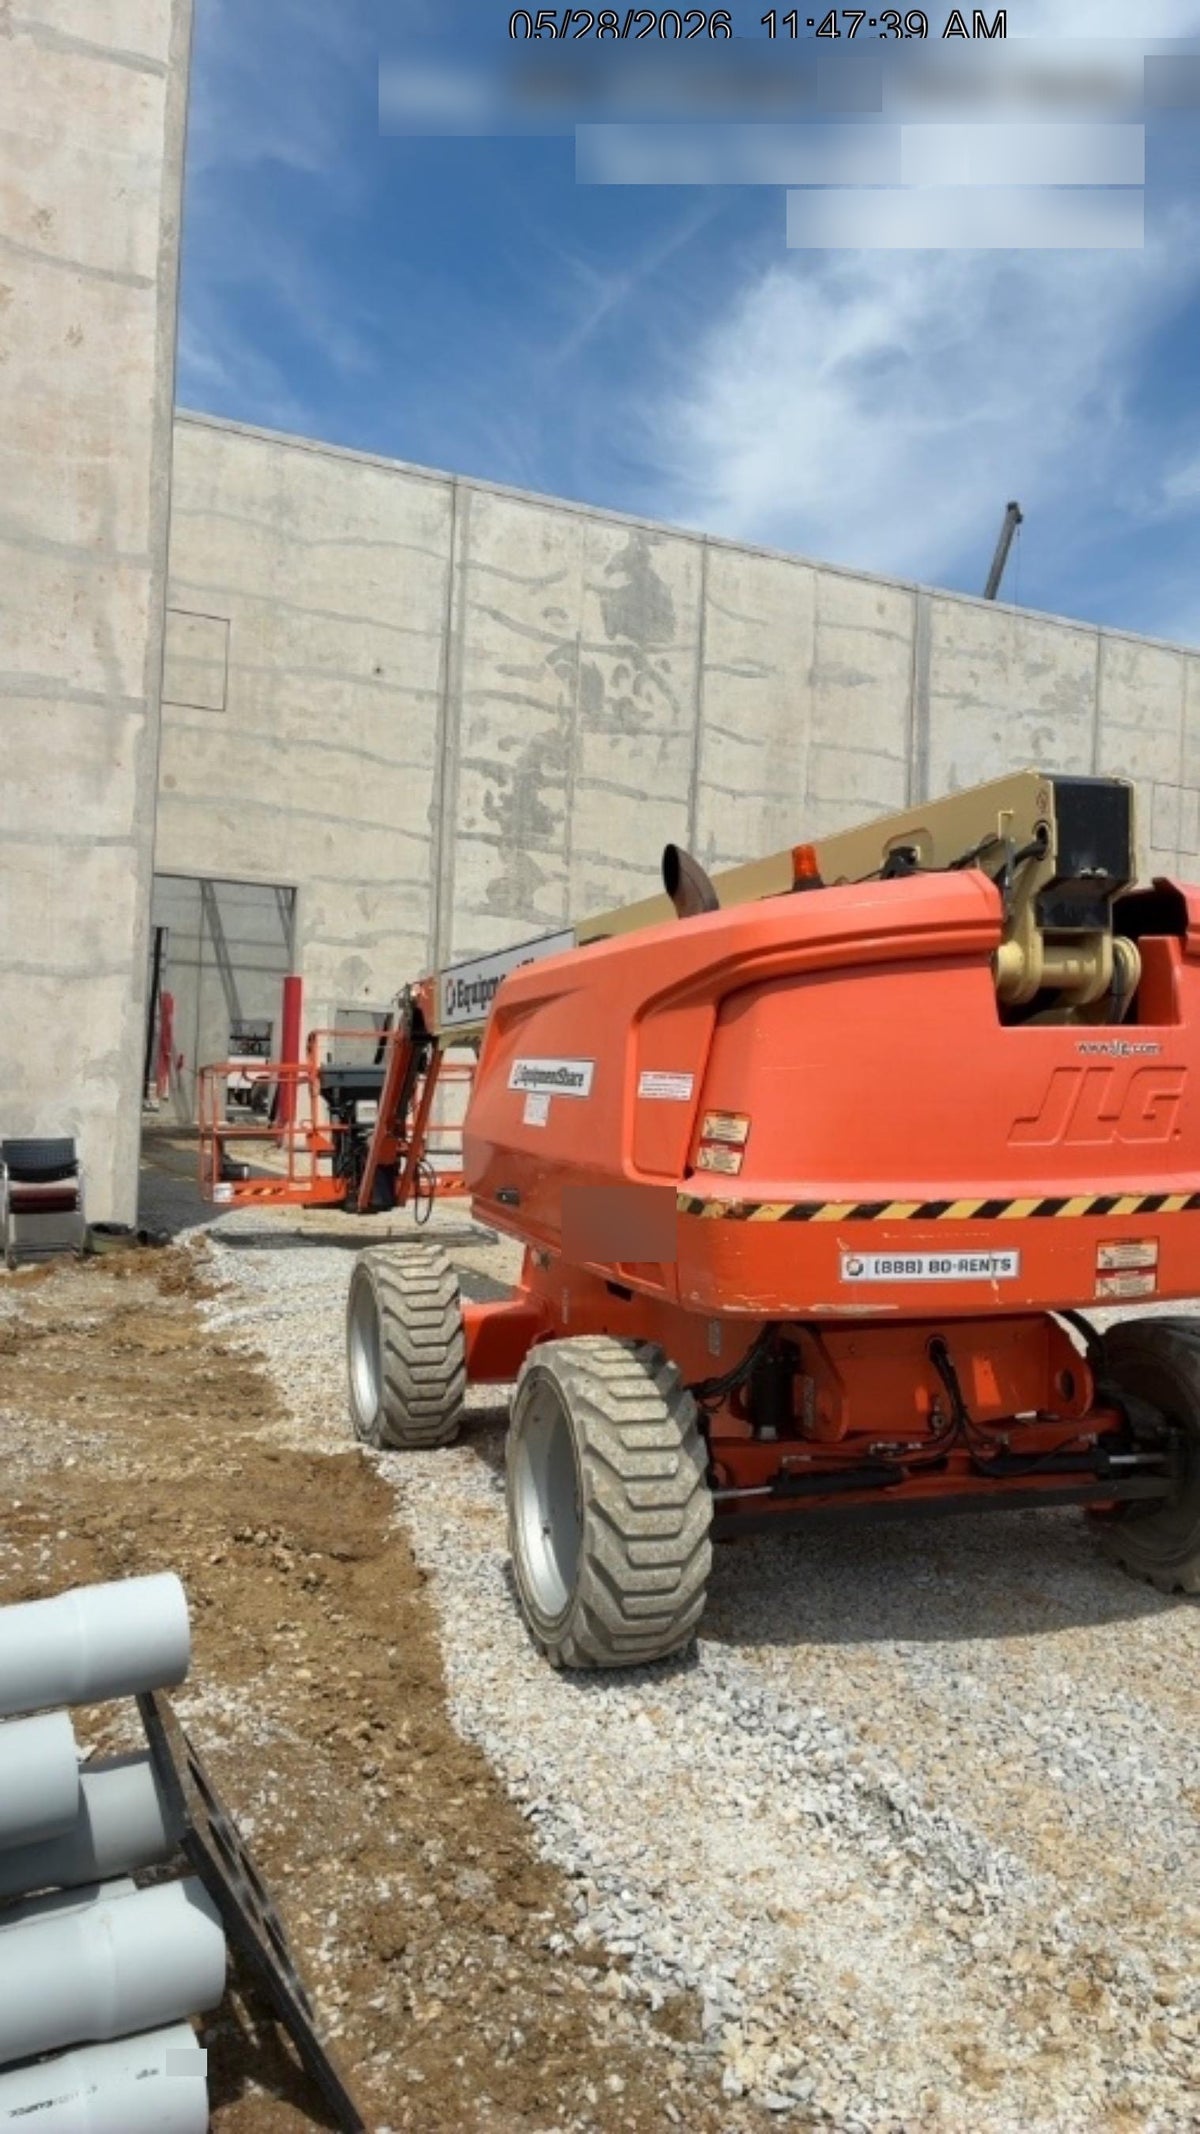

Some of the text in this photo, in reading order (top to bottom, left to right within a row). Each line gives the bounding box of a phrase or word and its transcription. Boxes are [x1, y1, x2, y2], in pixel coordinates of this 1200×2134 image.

[1078, 1040, 1159, 1057] www.jlg.com
[520, 1065, 585, 1088] EquipmentShare
[1007, 1066, 1187, 1146] JLG
